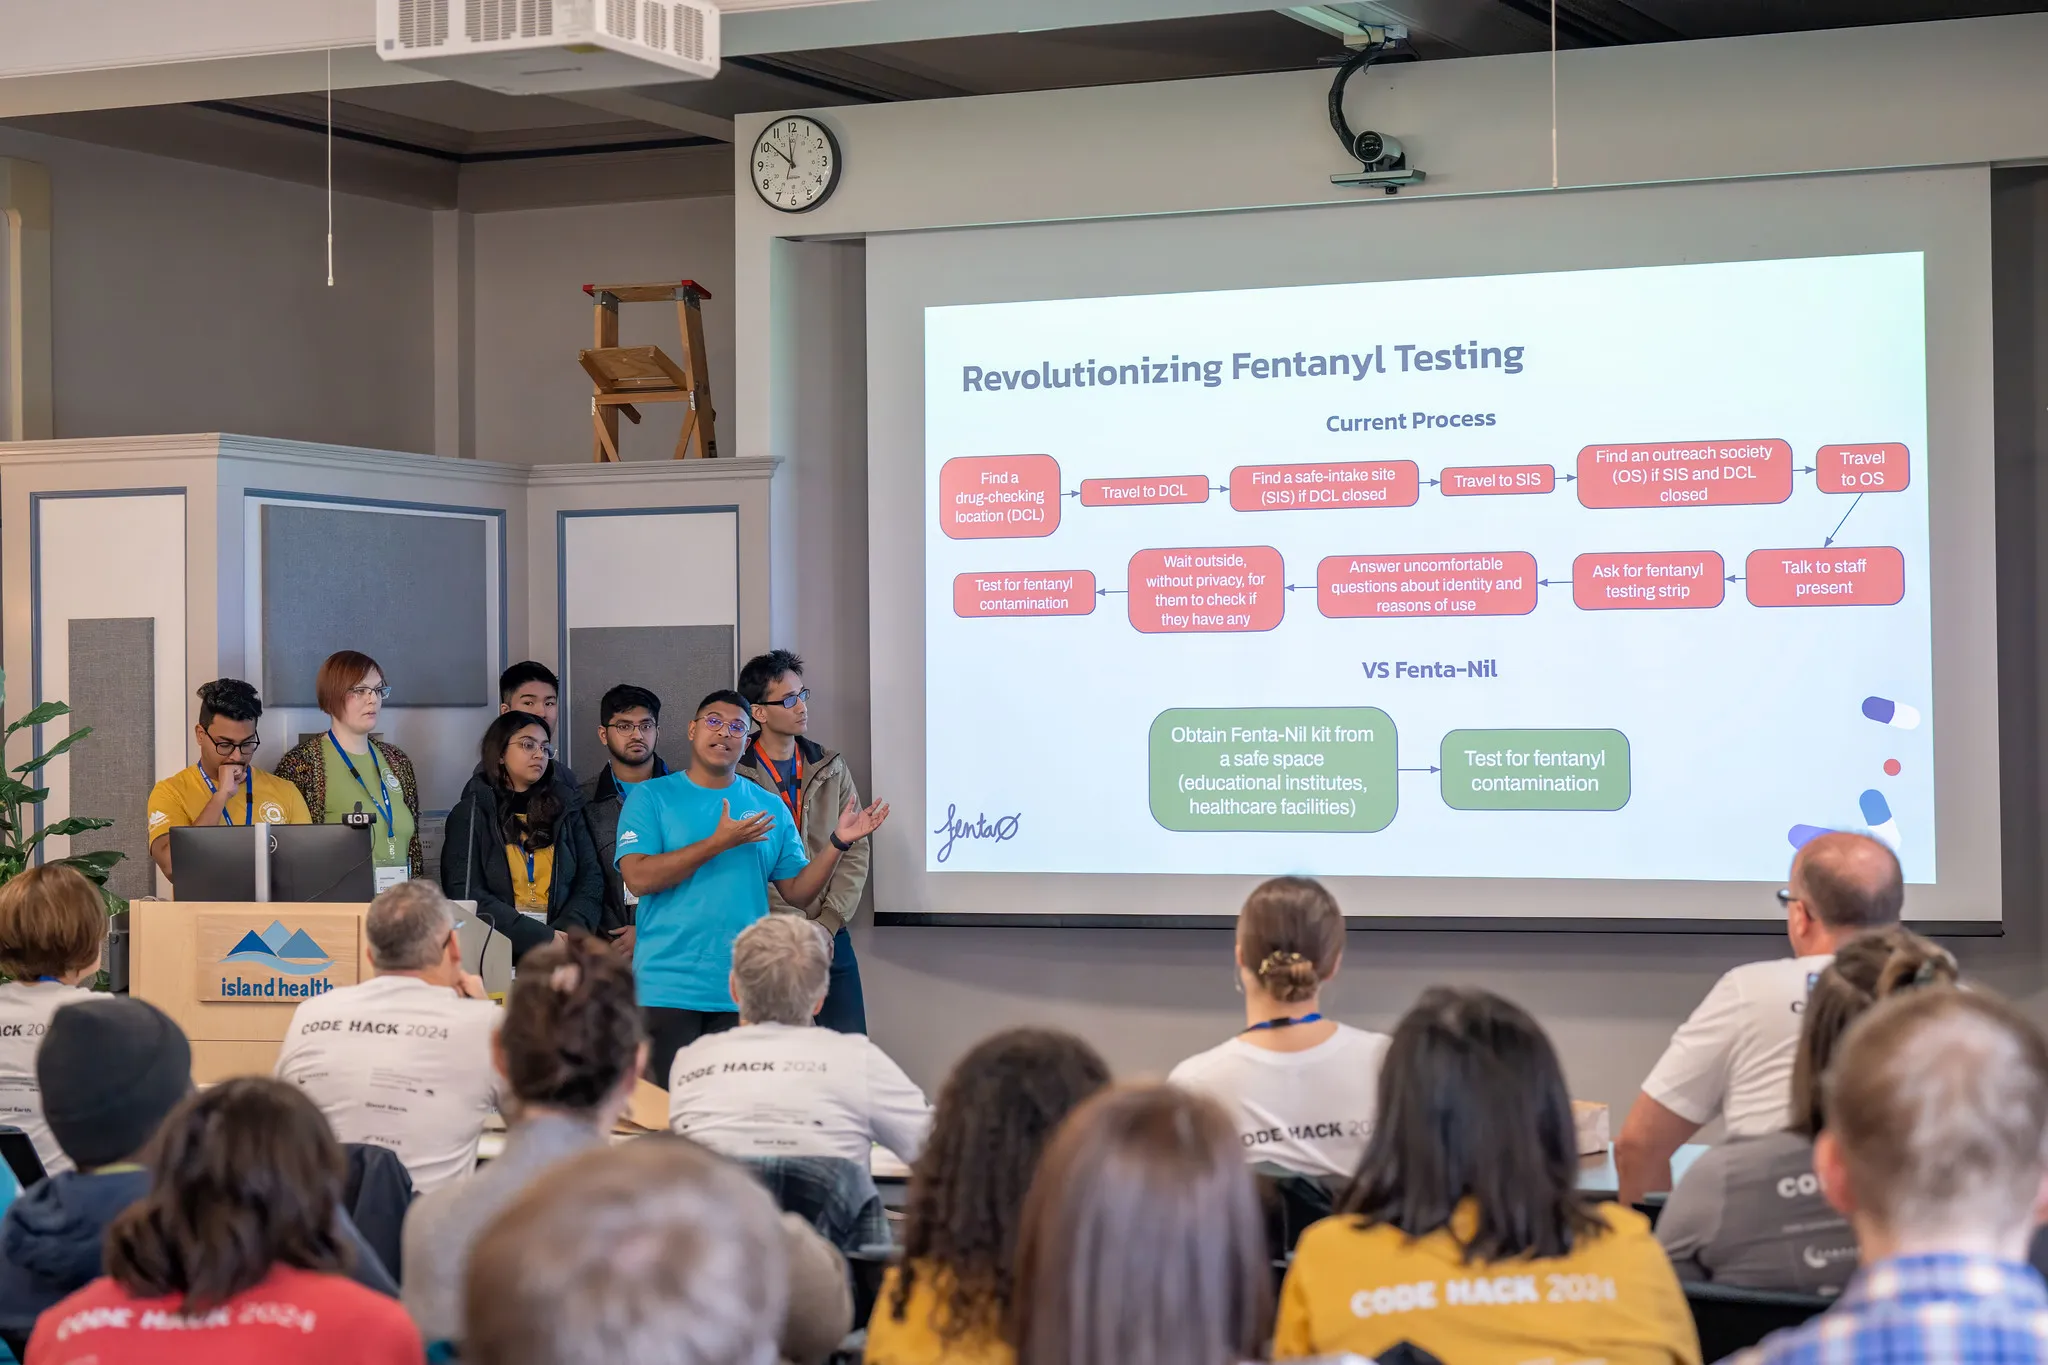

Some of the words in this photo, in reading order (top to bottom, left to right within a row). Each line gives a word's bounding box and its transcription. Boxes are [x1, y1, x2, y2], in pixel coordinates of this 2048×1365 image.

[773, 128, 780, 139] 11
[788, 122, 797, 133] 12
[807, 125, 810, 137] 1
[761, 142, 770, 153] 10
[816, 138, 824, 149] 2
[757, 161, 764, 172] 9
[821, 155, 828, 167] 3
[763, 179, 770, 190] 8
[815, 175, 823, 185] 4
[775, 192, 782, 202] 7
[790, 195, 797, 206] 6
[806, 189, 813, 201] 5
[963, 355, 1222, 391] Revolutionizing
[1233, 345, 1385, 381] Fentanyl
[1394, 341, 1524, 374] Testing
[1326, 413, 1408, 433] Current
[1412, 411, 1497, 429] Process
[1596, 449, 1628, 463] Find
[1631, 451, 1649, 463] an
[1652, 446, 1717, 462] outreach
[1719, 444, 1773, 461] society
[1839, 450, 1886, 465] Travel
[981, 471, 1008, 485] Find
[1010, 473, 1019, 484] a
[1252, 471, 1281, 485] Find
[1283, 473, 1293, 484] a
[1295, 468, 1369, 484] safe-intake
[1371, 467, 1396, 481] site
[1453, 473, 1496, 488] Travel
[1498, 474, 1513, 487] to
[1515, 472, 1541, 487] SIS
[1612, 468, 1648, 486] (OS)
[1651, 467, 1660, 482] if
[1662, 467, 1689, 482] SIS
[1692, 466, 1720, 481] and
[1723, 465, 1757, 480] DCL
[1840, 473, 1857, 487] to
[1859, 471, 1885, 486] OS
[955, 489, 1045, 507] drug-checking
[1101, 485, 1140, 499] Travel
[1142, 485, 1156, 498] to
[1158, 483, 1188, 497] DCL
[1261, 489, 1295, 507] (SIS)
[1298, 489, 1307, 503] if
[1309, 489, 1340, 503] DCL
[1341, 487, 1387, 502] closed
[1659, 487, 1708, 502] closed
[955, 510, 1004, 523] location
[1007, 507, 1045, 524] (DCL)
[1163, 554, 1193, 568] Wait
[1194, 553, 1247, 569] outside,
[1349, 560, 1401, 574] Answer
[1403, 556, 1504, 573] uncomfortable
[1781, 559, 1813, 574] Talk
[1815, 560, 1831, 574] to
[1834, 558, 1867, 574] staff
[1592, 564, 1620, 578] Ask
[1622, 563, 1644, 578] for
[1645, 562, 1704, 579] fentanyl
[975, 579, 1003, 592] Test
[1003, 578, 1022, 591] for
[1023, 576, 1073, 593] fentanyl
[1146, 574, 1194, 588] without
[1196, 573, 1245, 589] privacy,
[1247, 572, 1266, 586] for
[1331, 579, 1398, 596] questions
[1400, 578, 1440, 593] about
[1442, 577, 1493, 593] identity
[1495, 576, 1523, 591] and
[1796, 580, 1854, 597] present
[1155, 593, 1188, 607] them
[1190, 593, 1204, 606] to
[1206, 592, 1247, 606] check
[1249, 591, 1258, 605] if
[1605, 583, 1656, 601] testing
[1658, 583, 1691, 600] strip
[979, 596, 1069, 611] contamination
[1375, 599, 1432, 614] reasons
[1434, 597, 1449, 612] of
[1451, 600, 1477, 612] use
[1161, 612, 1190, 629] they
[1192, 612, 1224, 626] have
[1226, 614, 1251, 628] any
[1361, 661, 1390, 679] VS
[1395, 659, 1498, 679] Fenta-Nil
[1171, 726, 1227, 743] Obtain
[1231, 725, 1307, 743] Fenta-Nil
[1311, 725, 1332, 743] kit
[1334, 725, 1374, 743] from
[1219, 754, 1231, 767] a
[1233, 749, 1270, 767] safe
[1272, 753, 1325, 770] space
[1463, 750, 1503, 767] Test
[1505, 749, 1531, 767] for
[1533, 749, 1605, 770] fentanyl
[1178, 773, 1282, 794] (educational
[1285, 774, 1367, 794] institutes,
[1471, 774, 1599, 792] contamination
[1189, 798, 1278, 815] healthcare
[1280, 797, 1356, 818] facilities)
[221, 977, 275, 997] island
[0, 1024, 22, 1037] CK
[301, 1020, 343, 1036] CODE
[348, 1019, 400, 1036] HACK
[404, 1023, 449, 1041] 2024
[677, 1064, 717, 1087] CODE
[723, 1061, 776, 1074] HACK
[782, 1060, 828, 1074] 2024
[1241, 1127, 1284, 1148] ODE
[1288, 1120, 1342, 1140] HACK
[1348, 1119, 1374, 1136] 20
[1350, 1279, 1438, 1319] CODE
[1445, 1275, 1539, 1305] HACK
